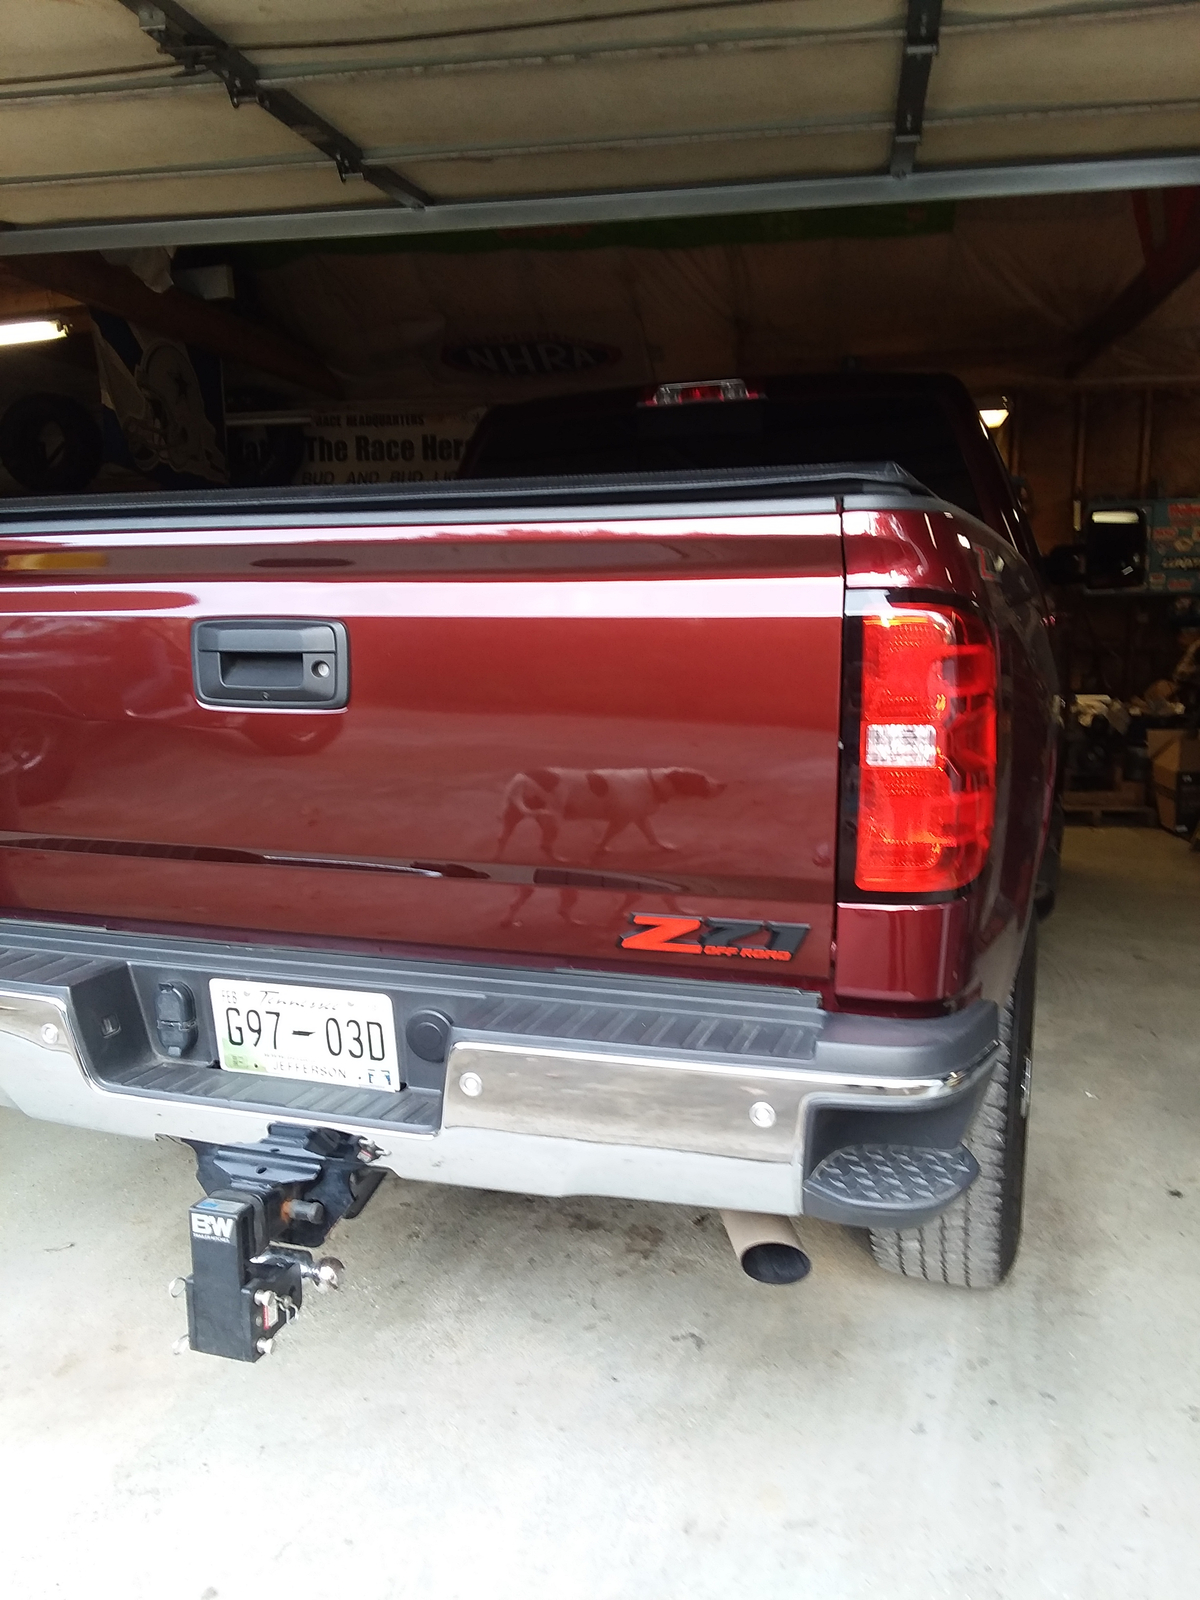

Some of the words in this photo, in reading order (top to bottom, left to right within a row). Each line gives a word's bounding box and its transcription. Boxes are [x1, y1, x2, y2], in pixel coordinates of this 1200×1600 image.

[464, 342, 597, 375] NHRA
[346, 412, 424, 427] HEADQUARTERS
[302, 434, 348, 462] The
[355, 433, 414, 461] Race
[421, 432, 467, 462] Her
[302, 471, 335, 485] BUD
[346, 470, 380, 484] AND
[389, 470, 424, 483] BUD
[616, 912, 811, 955] Z71
[273, 1061, 347, 1079] JEFFERSON
